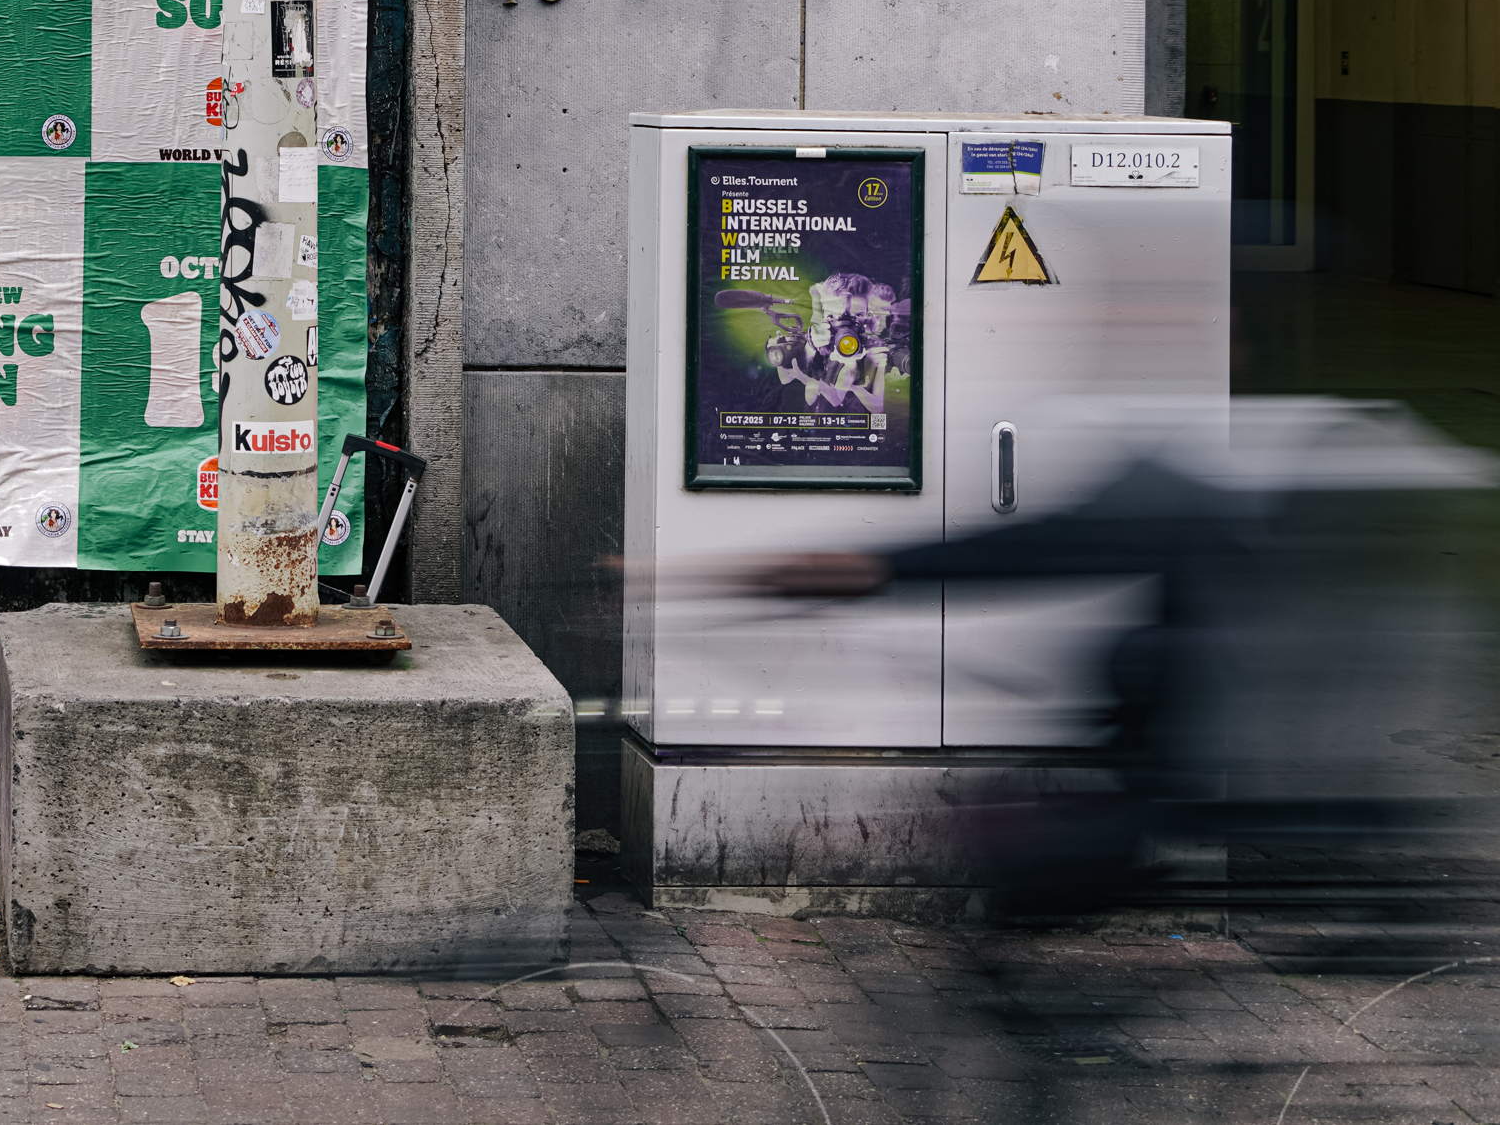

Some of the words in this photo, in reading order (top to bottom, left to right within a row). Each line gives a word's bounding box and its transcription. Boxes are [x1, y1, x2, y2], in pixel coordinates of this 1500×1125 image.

[160, 149, 210, 162] WORLD
[1092, 152, 1180, 168] D12.010.2
[723, 176, 798, 187] Elles.Tournent
[722, 199, 808, 215] BRUSSELS
[721, 216, 857, 231] INTERNATIONAL
[721, 233, 801, 247] WOMEN'S
[721, 249, 760, 264] FILM
[721, 266, 799, 281] FESTIVAL
[744, 416, 764, 425] 2025
[773, 417, 797, 425] 07-12
[822, 417, 846, 425] 13-15
[178, 529, 213, 543] STAY
